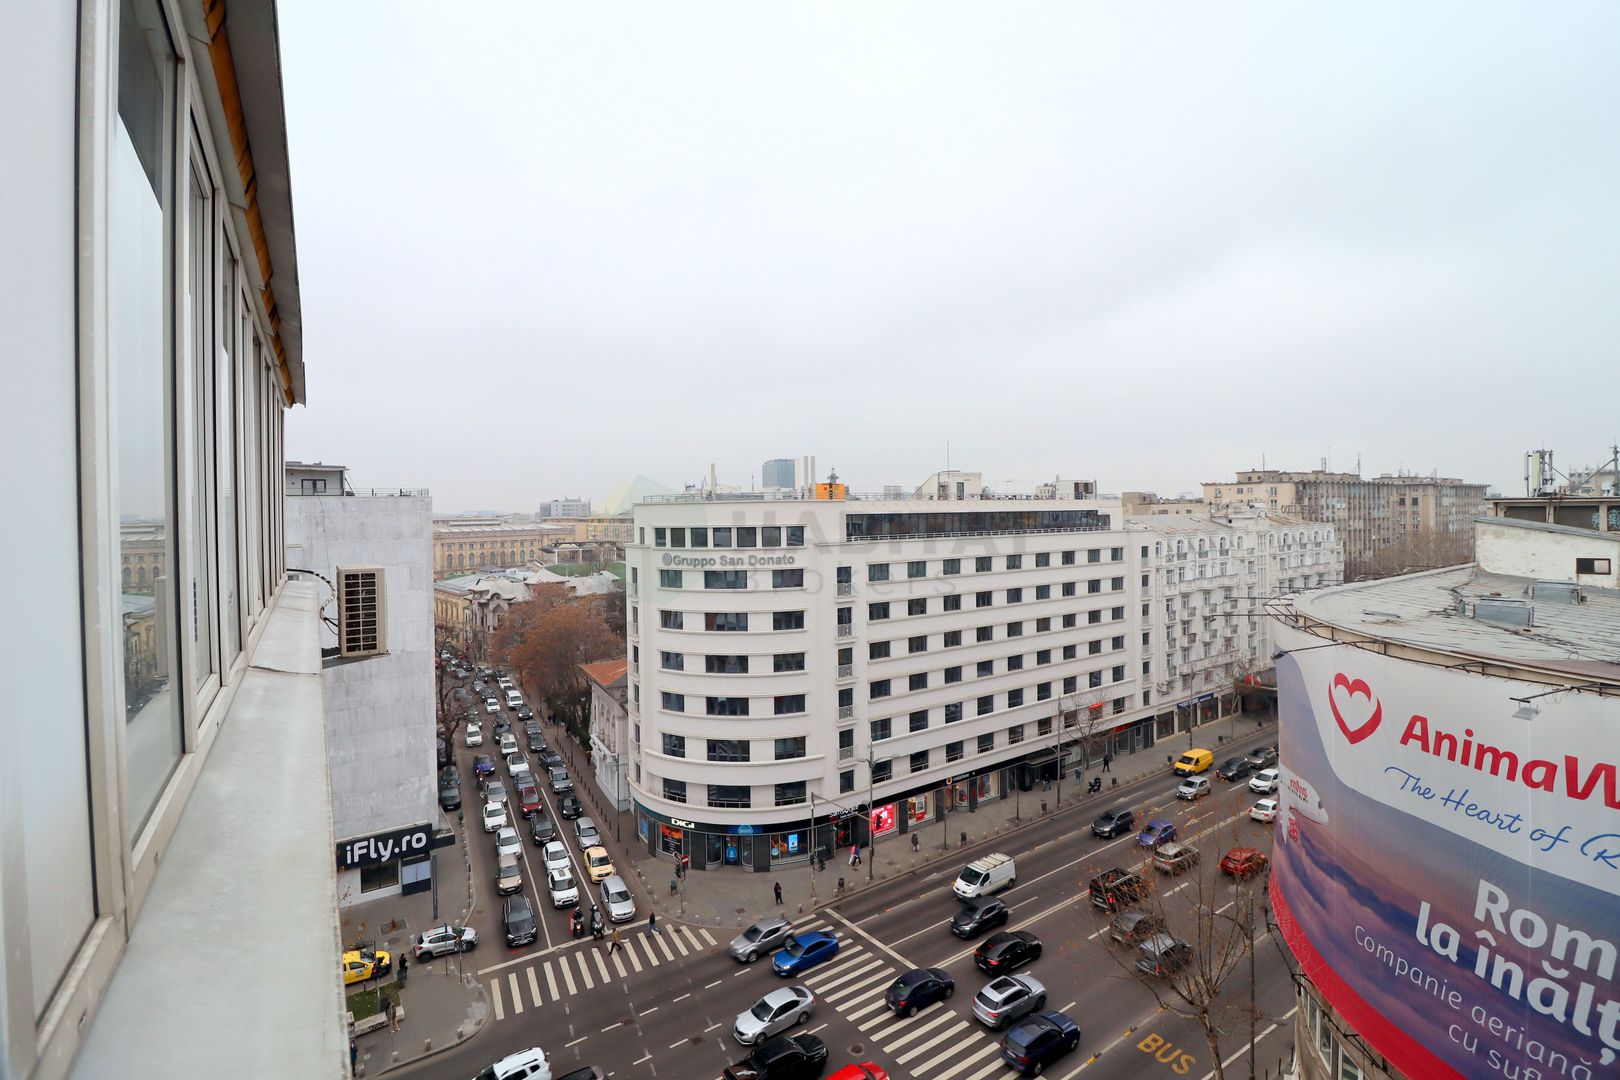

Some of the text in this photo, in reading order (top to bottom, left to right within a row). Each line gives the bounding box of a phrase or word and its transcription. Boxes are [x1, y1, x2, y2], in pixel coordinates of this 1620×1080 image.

[673, 553, 796, 567] Gruppo San Donato
[671, 818, 695, 829] DIGI
[1384, 766, 1436, 800] The
[1440, 788, 1524, 834] Heart
[1529, 826, 1572, 852] of
[345, 832, 427, 864] iFly.ro
[1416, 901, 1461, 963] la
[1474, 878, 1618, 981] Rom
[1354, 925, 1592, 1080] Companie aeriană
[1136, 1032, 1197, 1074] BUS
[1449, 1024, 1478, 1054] cu
